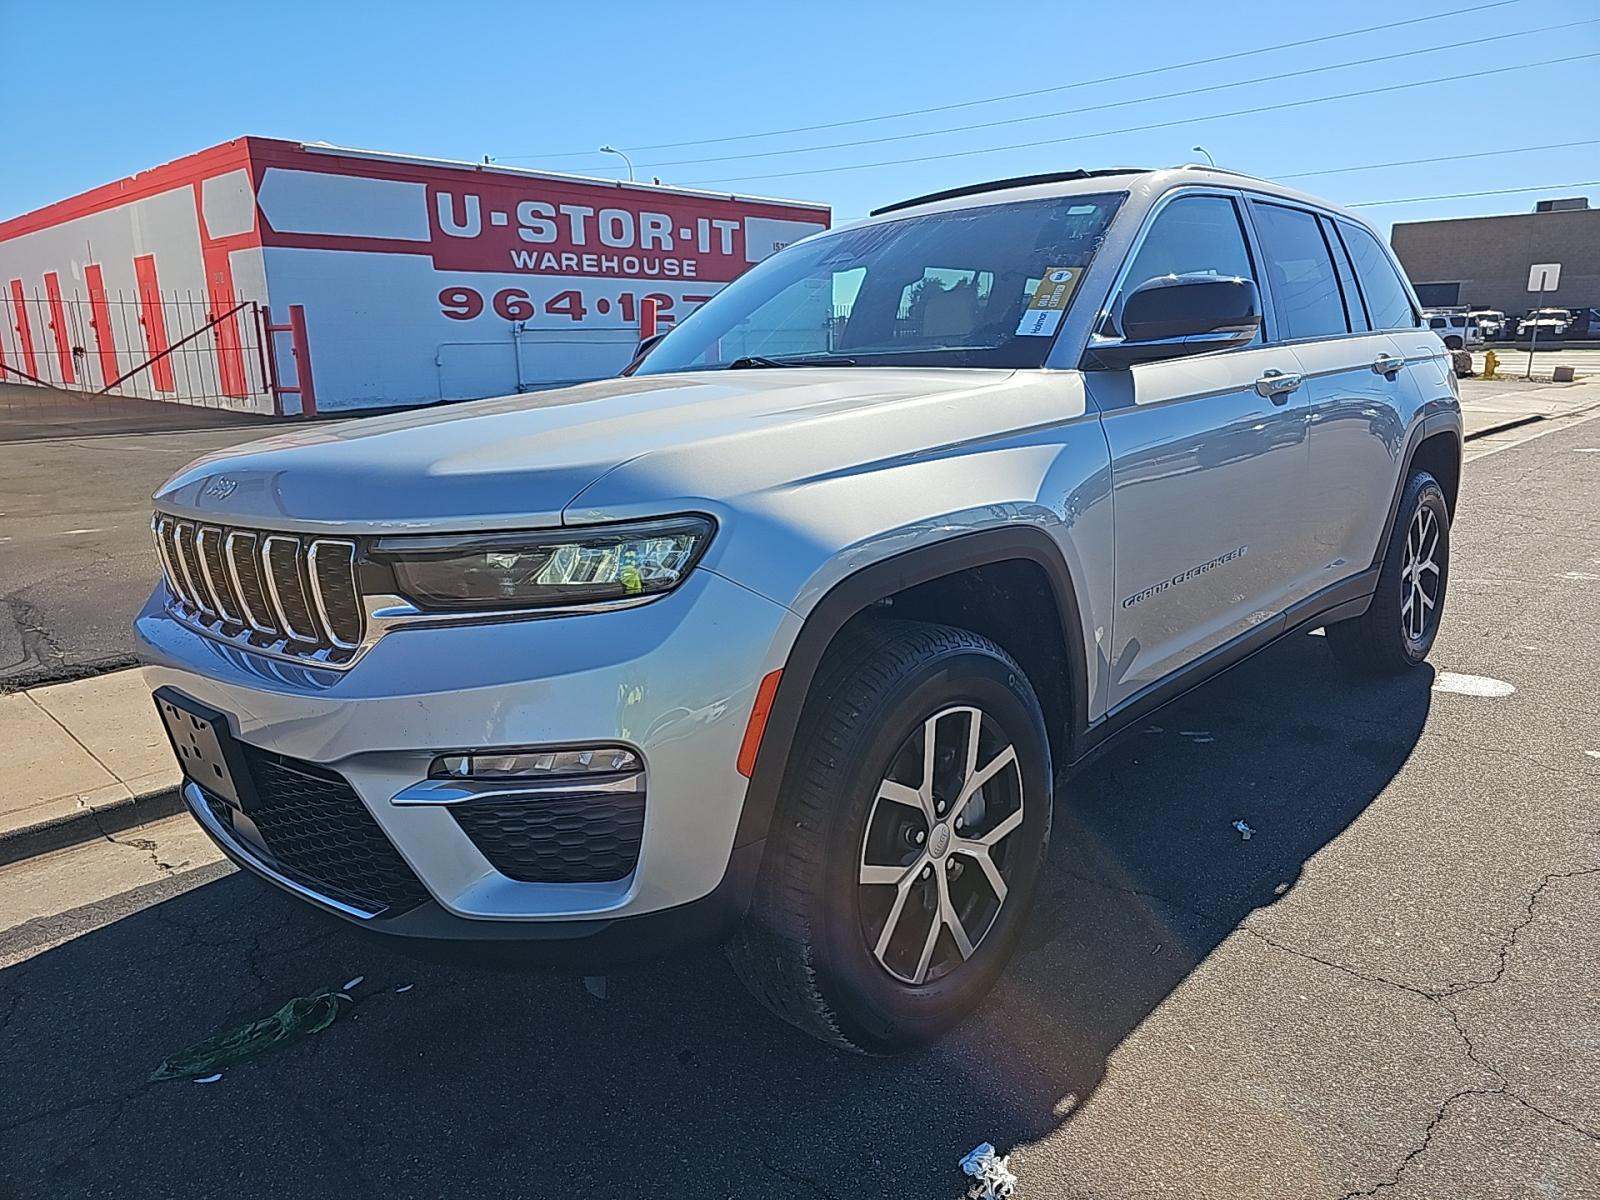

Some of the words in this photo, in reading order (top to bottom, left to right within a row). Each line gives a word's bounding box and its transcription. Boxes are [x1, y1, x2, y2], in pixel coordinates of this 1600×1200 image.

[510, 249, 697, 278] WAREHOUSE
[1122, 580, 1170, 609] GRAND
[1172, 550, 1239, 585] CHEROKEE
